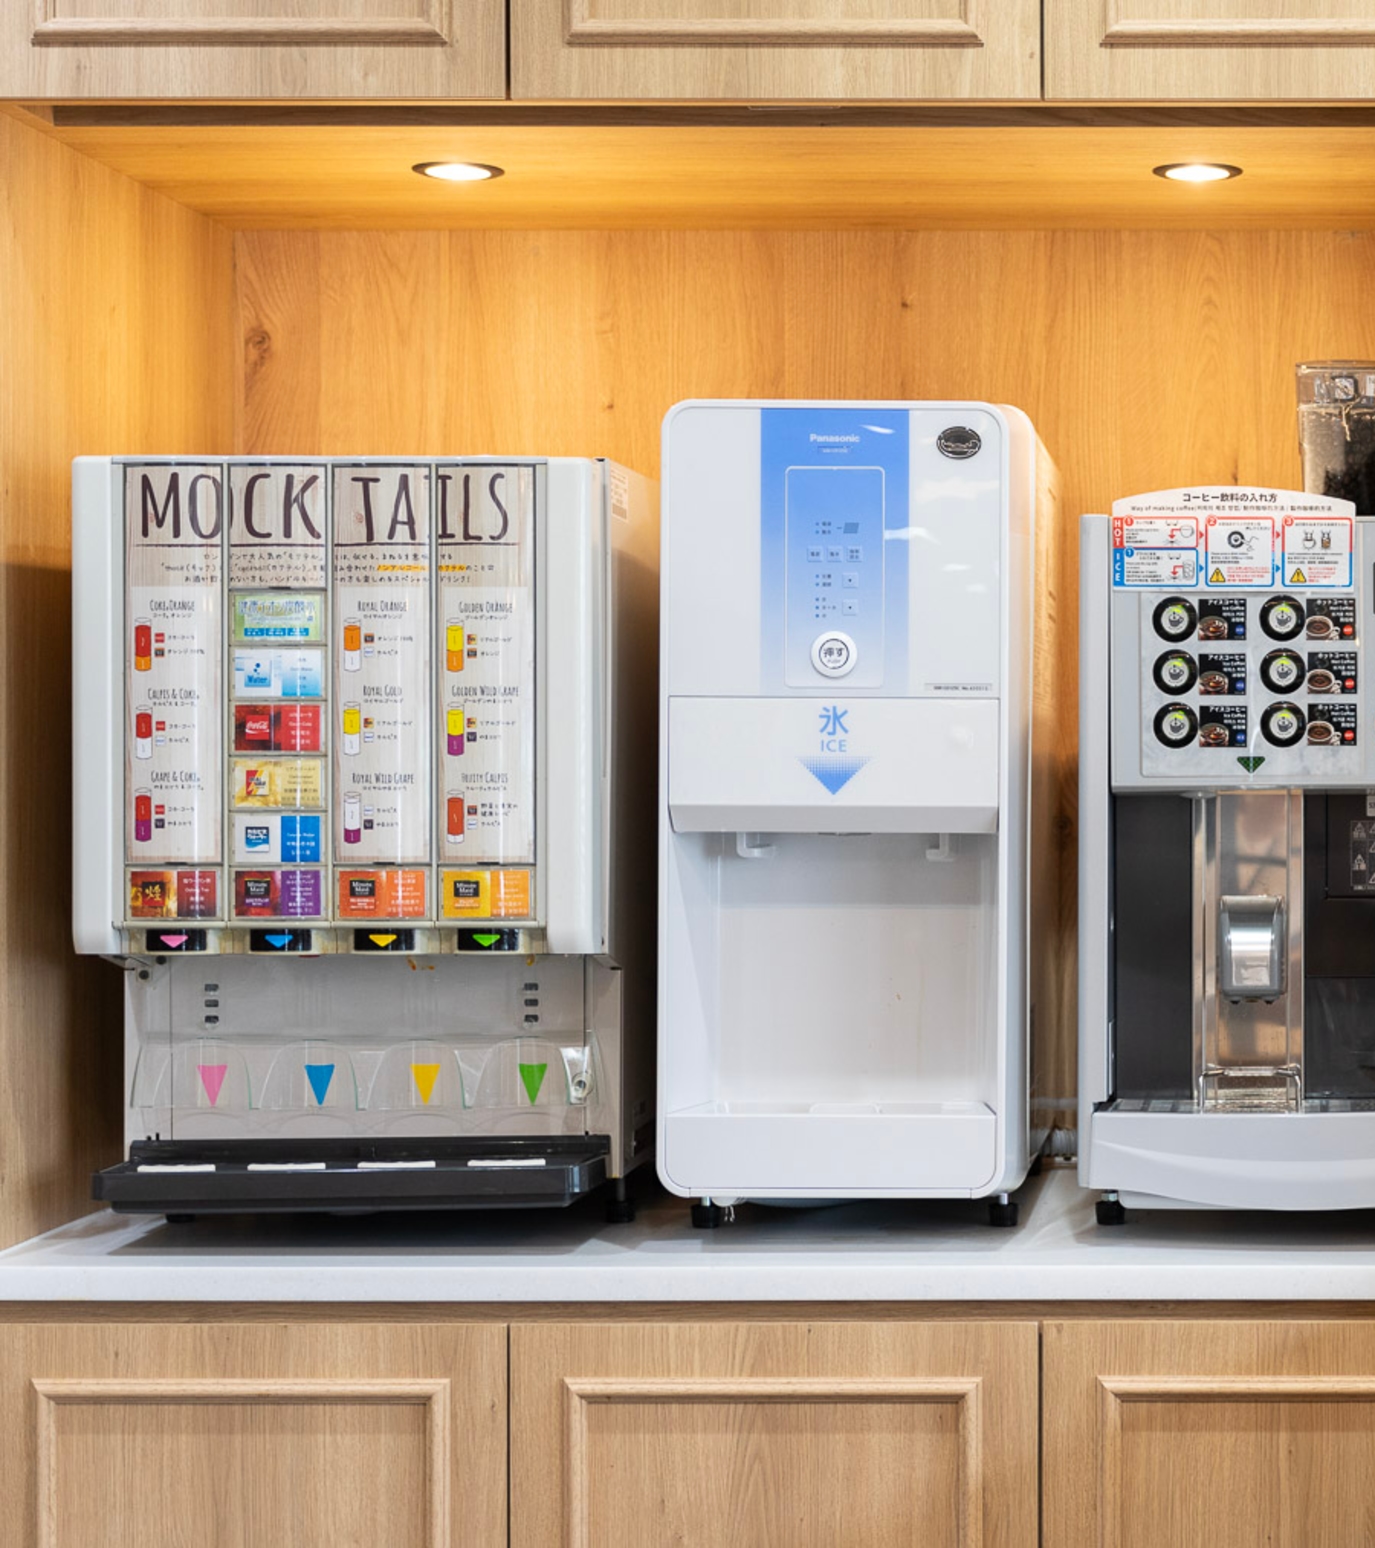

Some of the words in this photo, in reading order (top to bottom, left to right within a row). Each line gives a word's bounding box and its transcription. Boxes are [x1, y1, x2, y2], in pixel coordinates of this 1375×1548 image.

[809, 433, 861, 443] Panasonic
[141, 471, 322, 540] MOCK
[350, 472, 509, 542] TAILS
[1182, 492, 1278, 503] コーヒー飲料の入れ方
[1114, 517, 1122, 547] HOT
[1114, 552, 1122, 582] ICE
[823, 647, 846, 658] 押す
[818, 705, 850, 736] 氷
[821, 739, 848, 753] ICE
